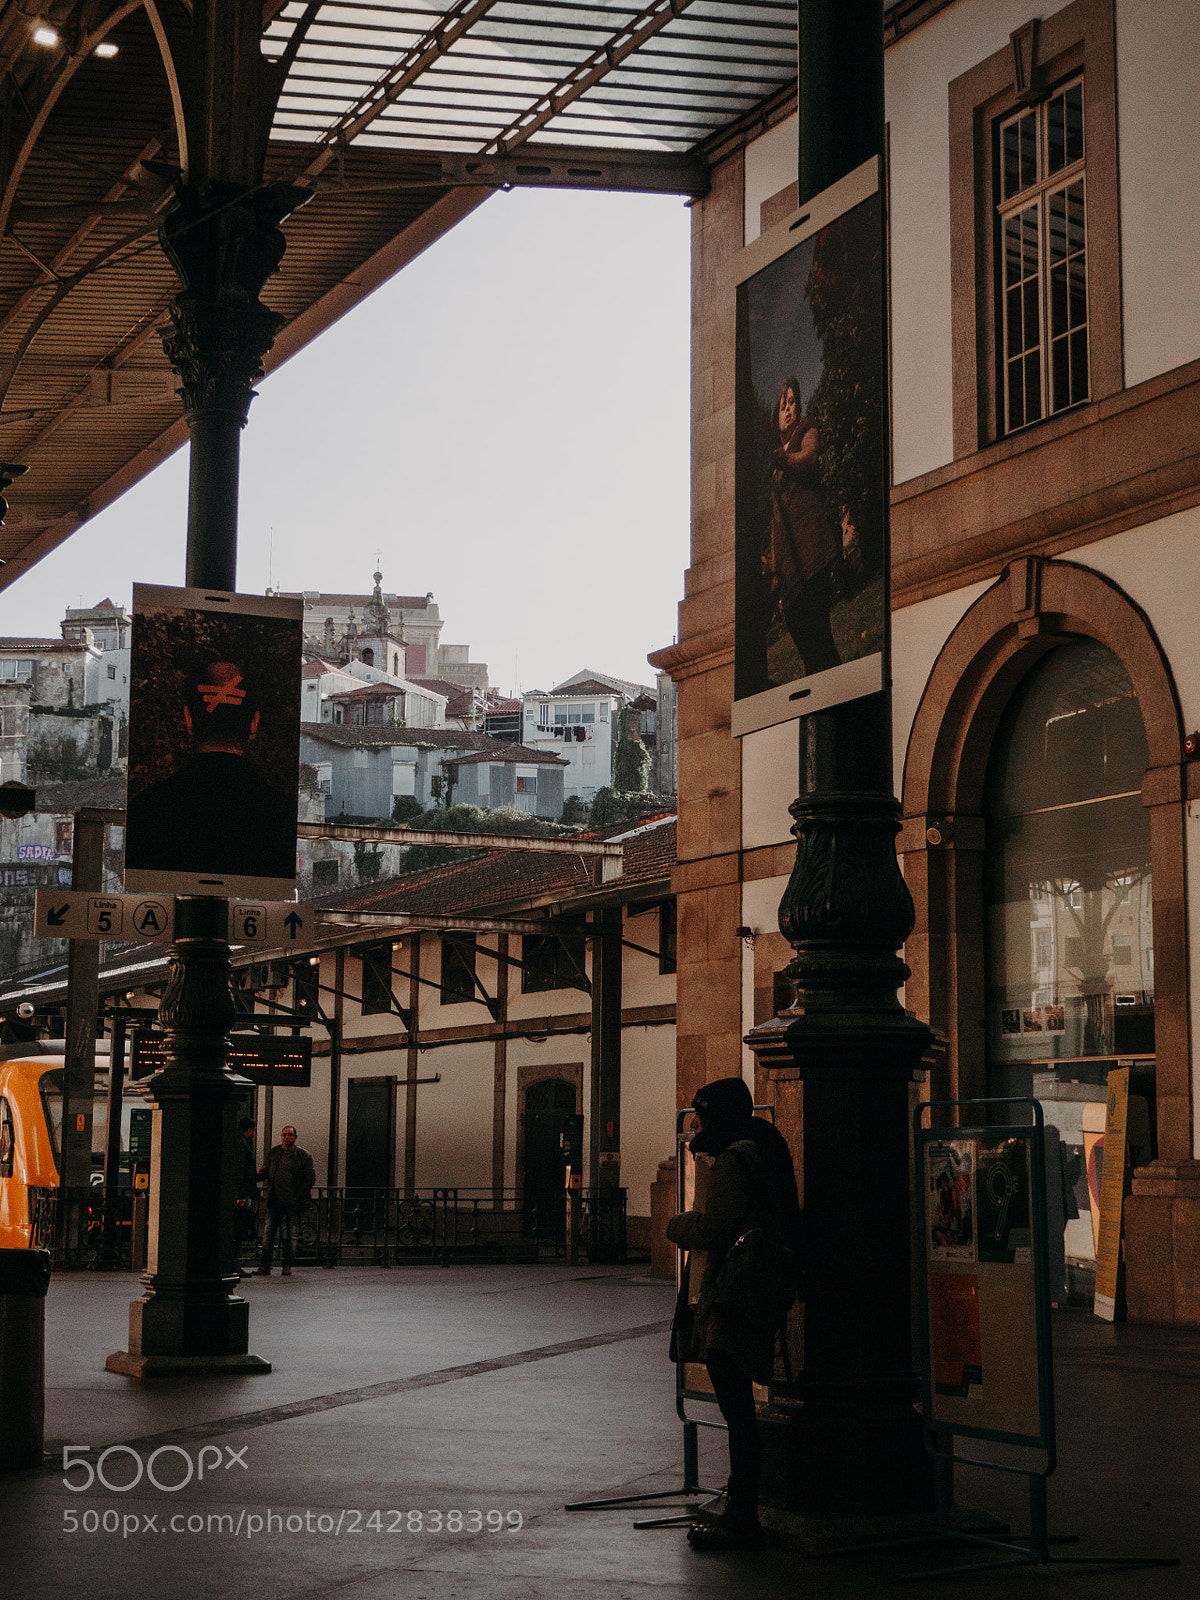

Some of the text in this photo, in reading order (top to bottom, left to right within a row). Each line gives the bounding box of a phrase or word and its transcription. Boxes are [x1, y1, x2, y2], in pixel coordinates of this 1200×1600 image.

[94, 901, 117, 910] Linha
[239, 908, 261, 917] Linha
[98, 911, 112, 932] 5
[140, 909, 160, 930] A
[244, 916, 257, 938] 6
